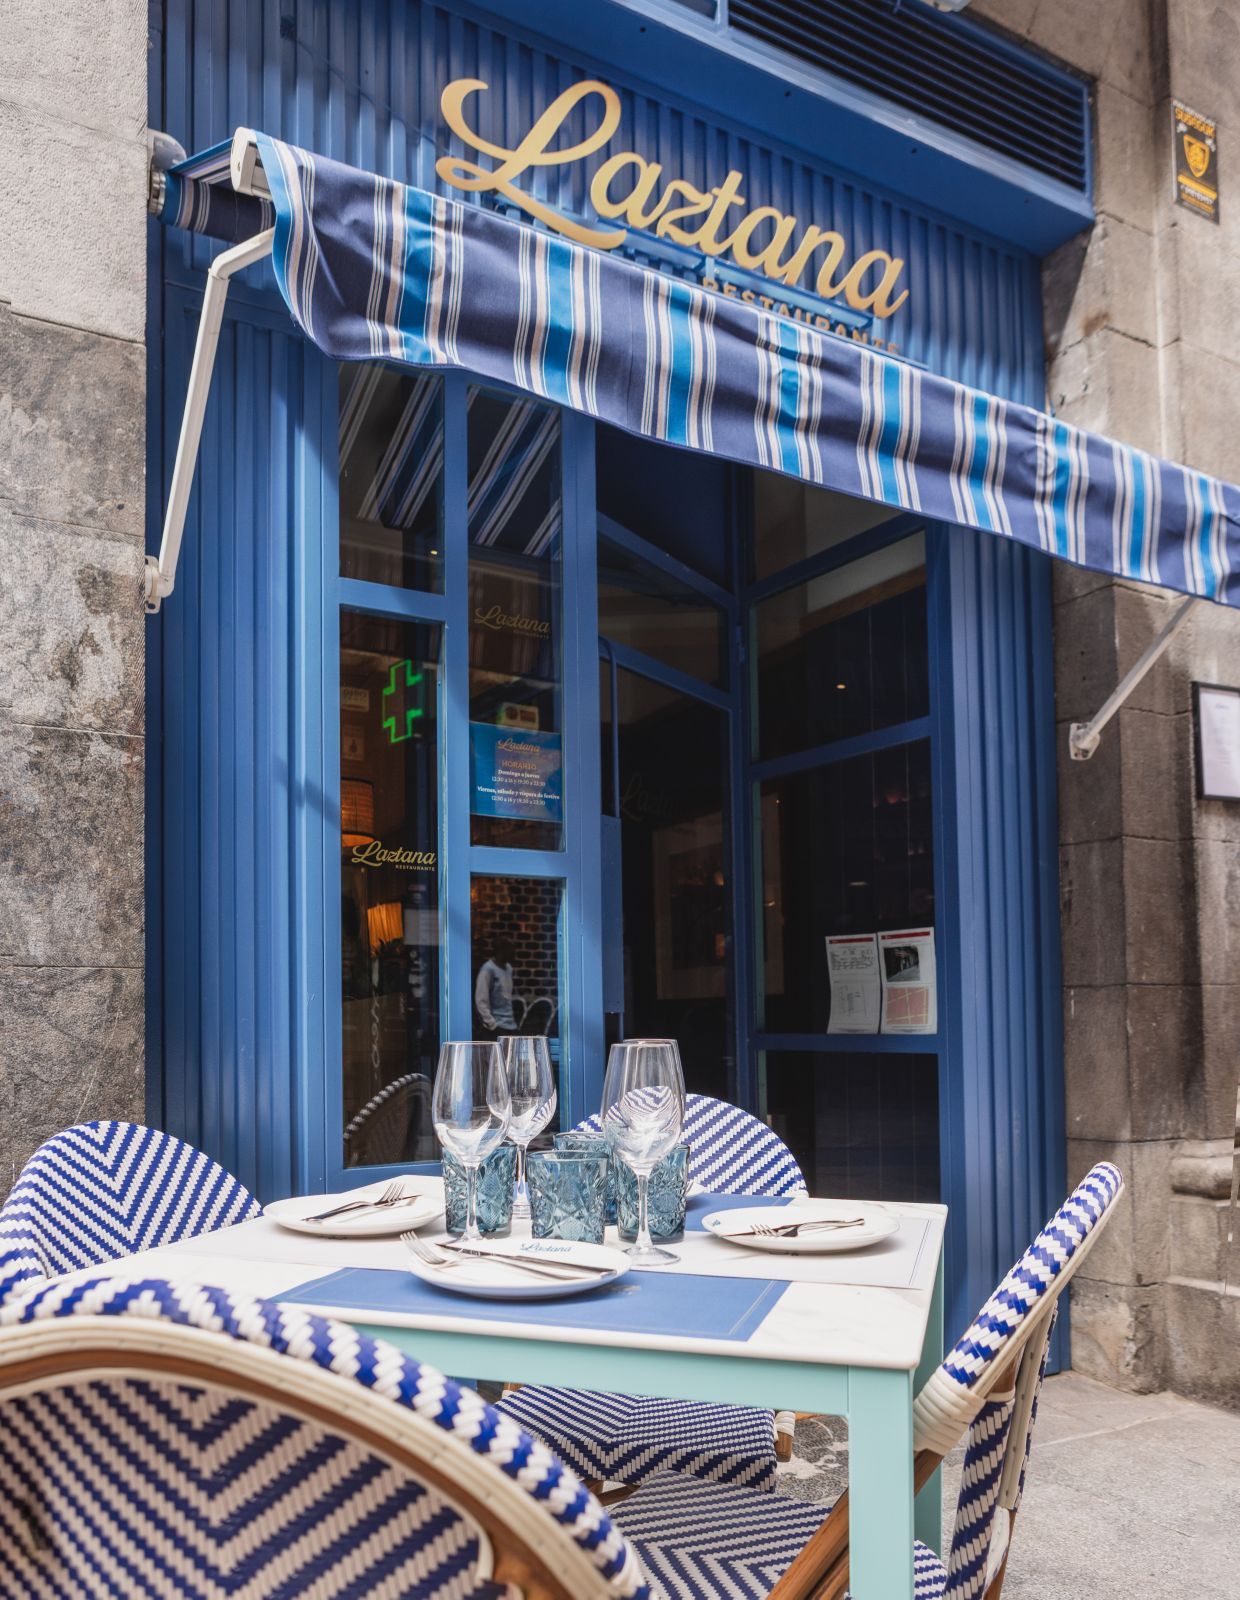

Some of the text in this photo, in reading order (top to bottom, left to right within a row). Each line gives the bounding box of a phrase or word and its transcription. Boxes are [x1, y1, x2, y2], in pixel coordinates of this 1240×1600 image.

[436, 78, 910, 319] Laztana
[474, 604, 550, 633] Laztana
[502, 760, 536, 769] HORARIO
[351, 840, 437, 867] Laztana
[395, 864, 436, 872] RESTAURANTE
